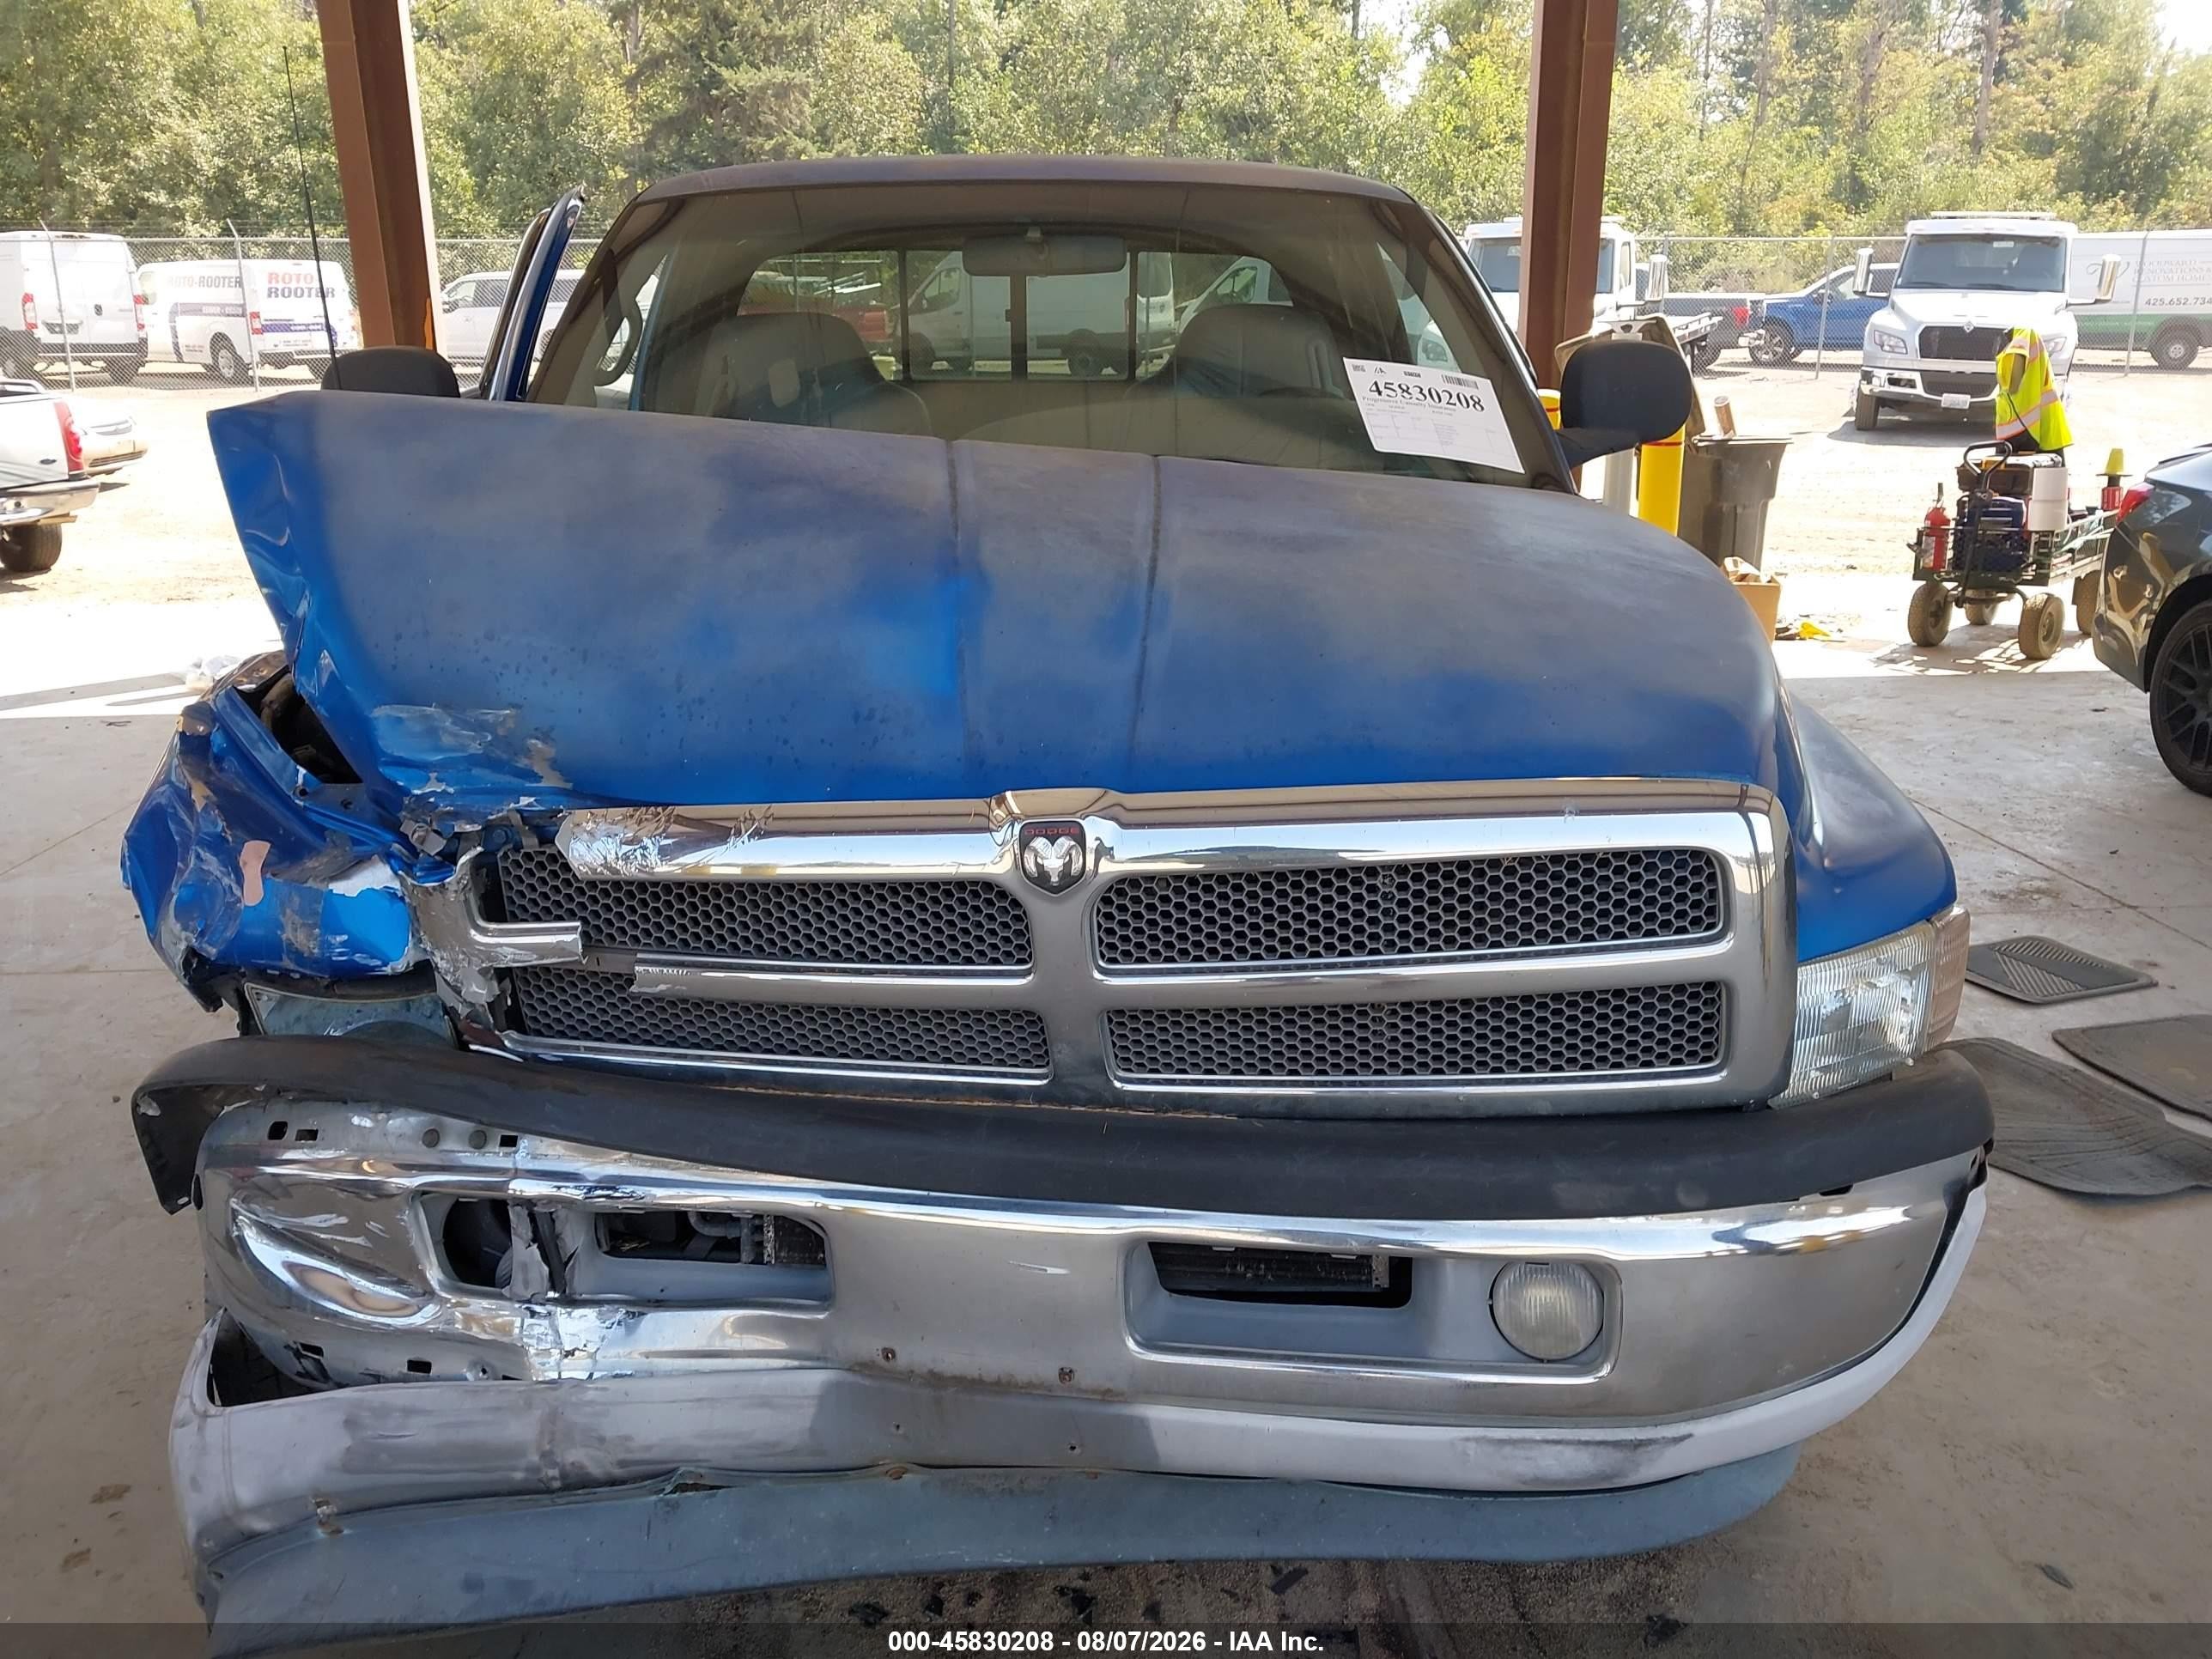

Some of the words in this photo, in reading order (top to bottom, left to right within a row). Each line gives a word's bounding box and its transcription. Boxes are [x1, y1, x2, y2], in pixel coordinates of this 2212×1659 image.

[267, 287, 336, 299] ROOTER
[1369, 380, 1485, 412] 45830208
[1024, 827, 1079, 836] DODGE
